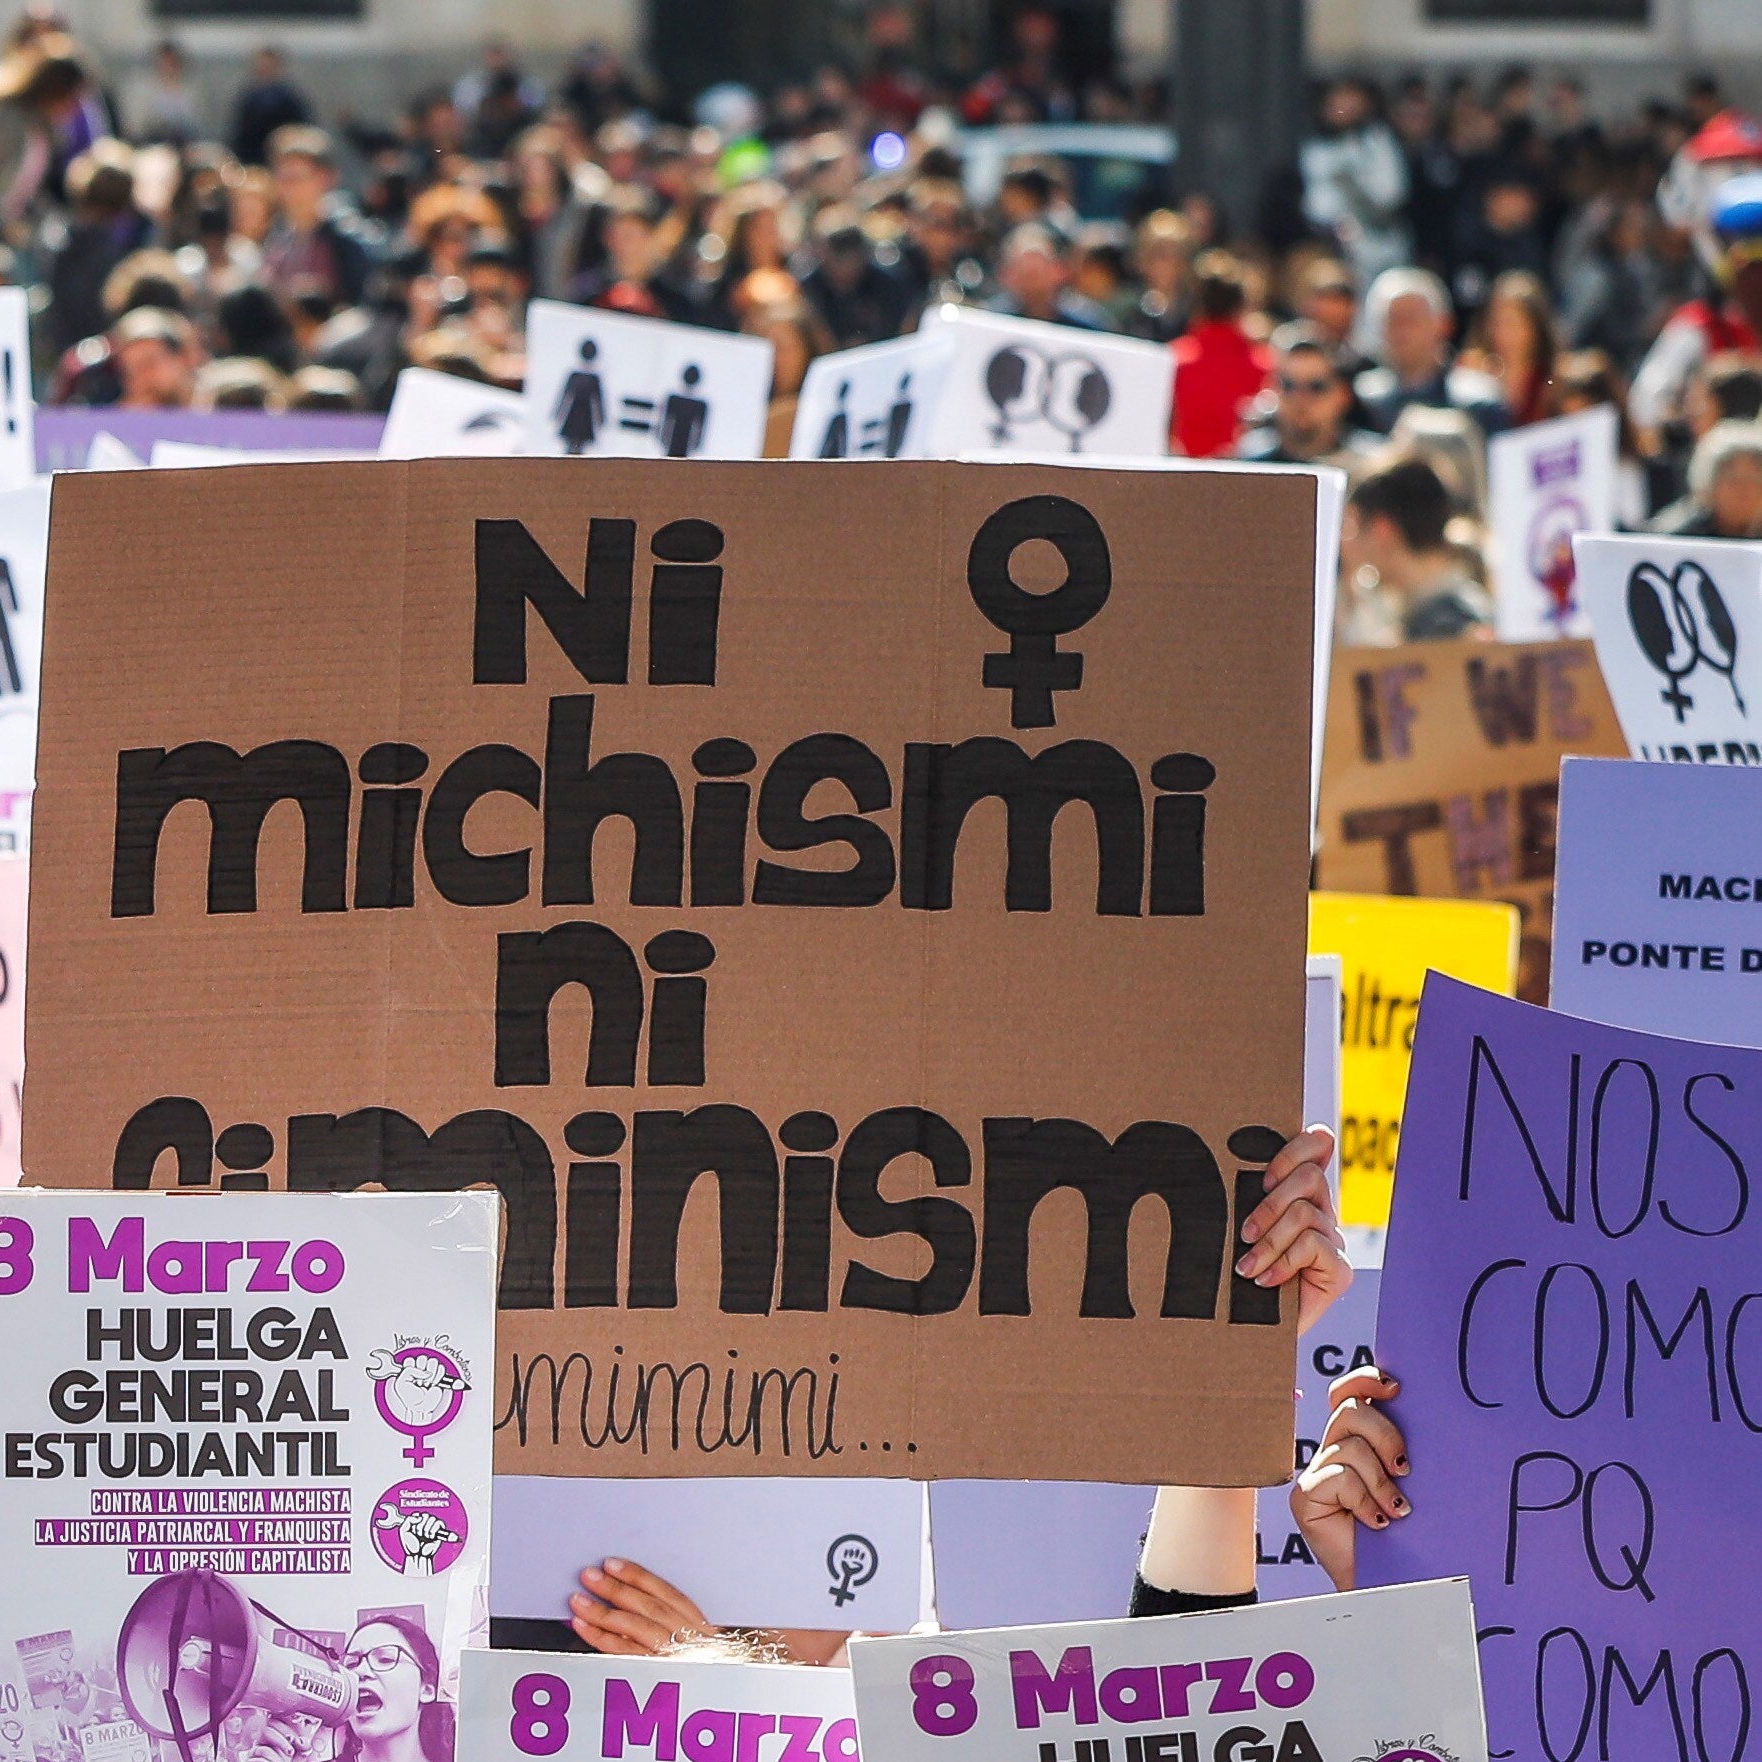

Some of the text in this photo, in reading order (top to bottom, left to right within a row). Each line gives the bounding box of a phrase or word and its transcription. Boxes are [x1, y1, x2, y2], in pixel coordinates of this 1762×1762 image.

[472, 517, 725, 688] Ni
[1352, 648, 1594, 764] IF WE
[109, 693, 1216, 918] michismi
[1581, 940, 1725, 973] PONTE
[494, 920, 716, 1090] ni
[1458, 1034, 1749, 1240] NOS
[67, 1216, 346, 1295] Marzo
[86, 1306, 349, 1363] HUELGA
[48, 1368, 350, 1425] GENERAL
[4, 1431, 352, 1480] ESTUDIANTIL
[1505, 1450, 1656, 1603] PQ
[510, 1673, 571, 1757] 8
[909, 1646, 1316, 1742] 8 Marzo
